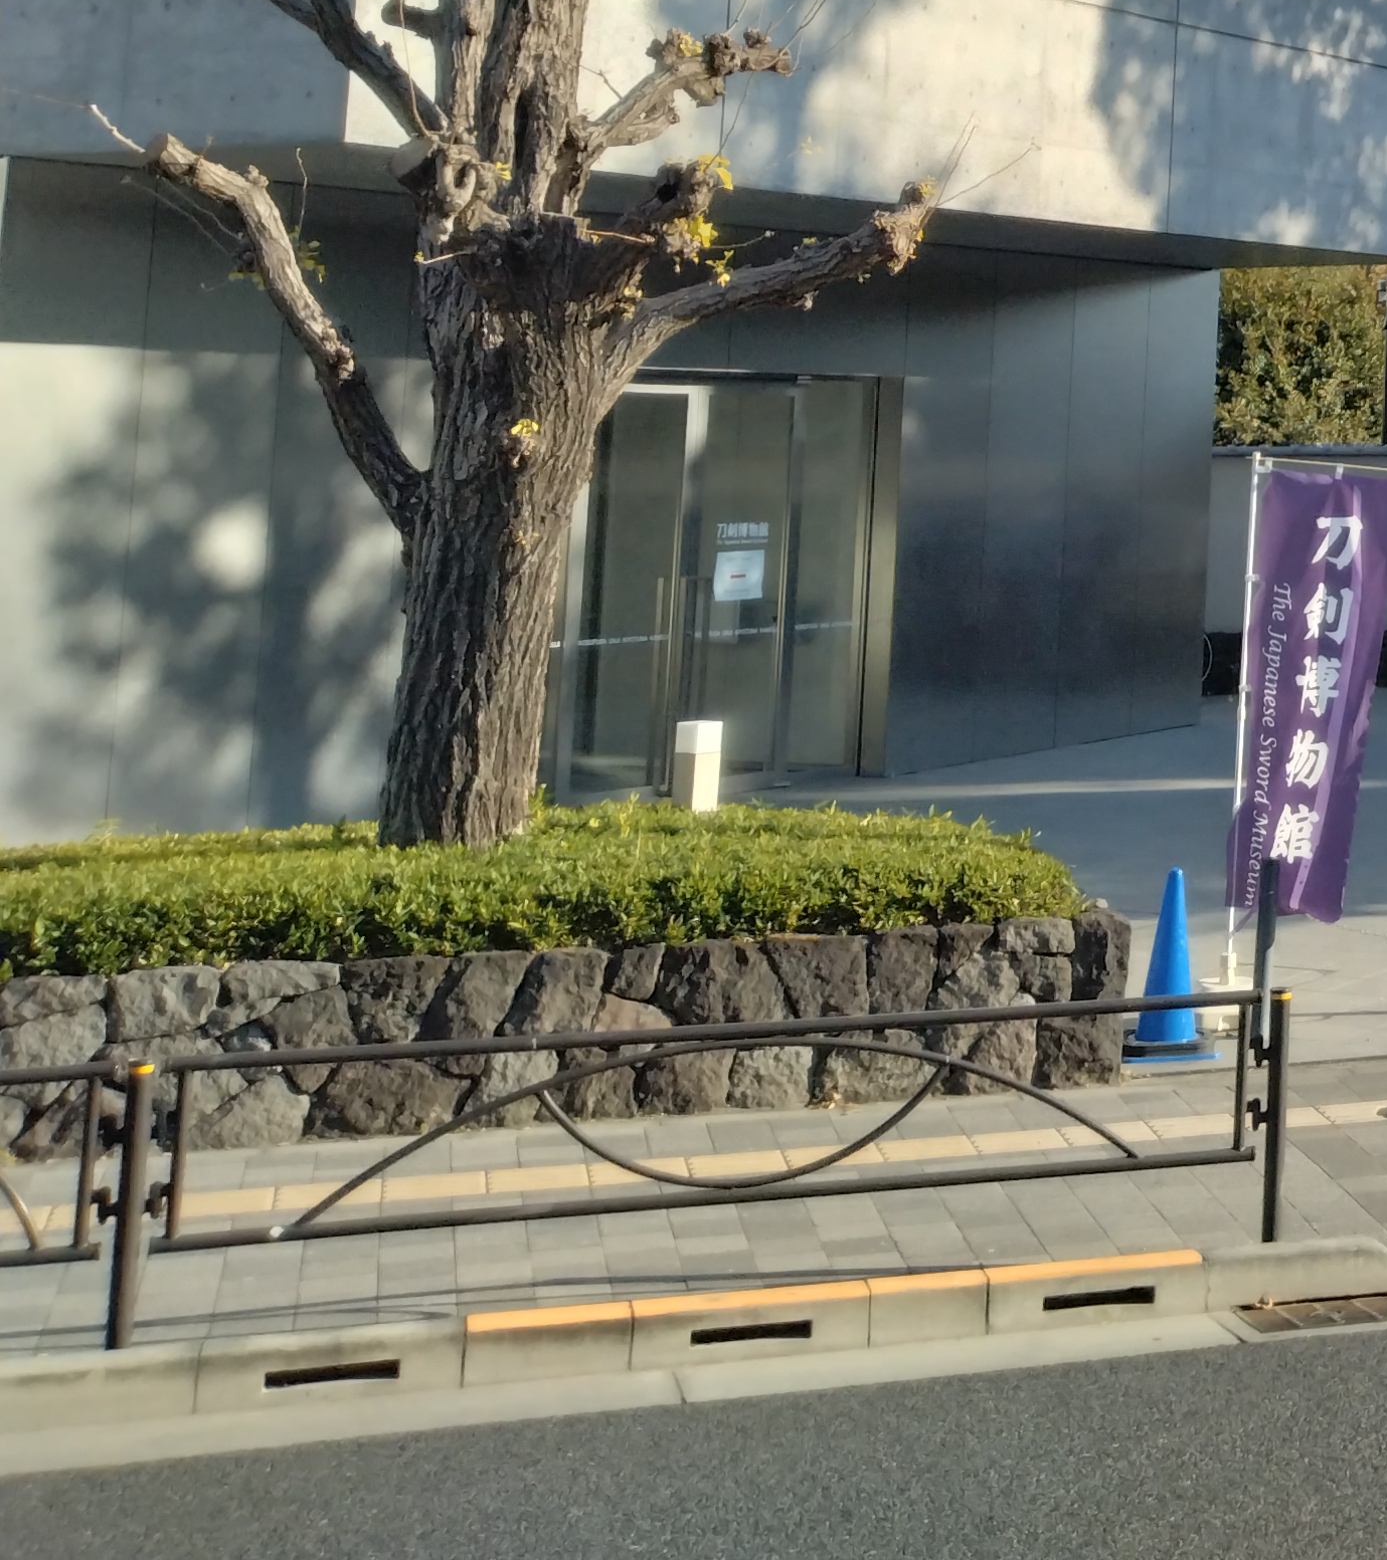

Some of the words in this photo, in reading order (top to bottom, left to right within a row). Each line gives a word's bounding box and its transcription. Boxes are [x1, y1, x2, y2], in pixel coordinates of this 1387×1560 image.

[1272, 582, 1292, 621] The
[1262, 625, 1287, 728] Japanese
[1269, 516, 1362, 864] 刀剣博物館
[1254, 733, 1277, 811] Sword
[1245, 809, 1269, 907] Museum
